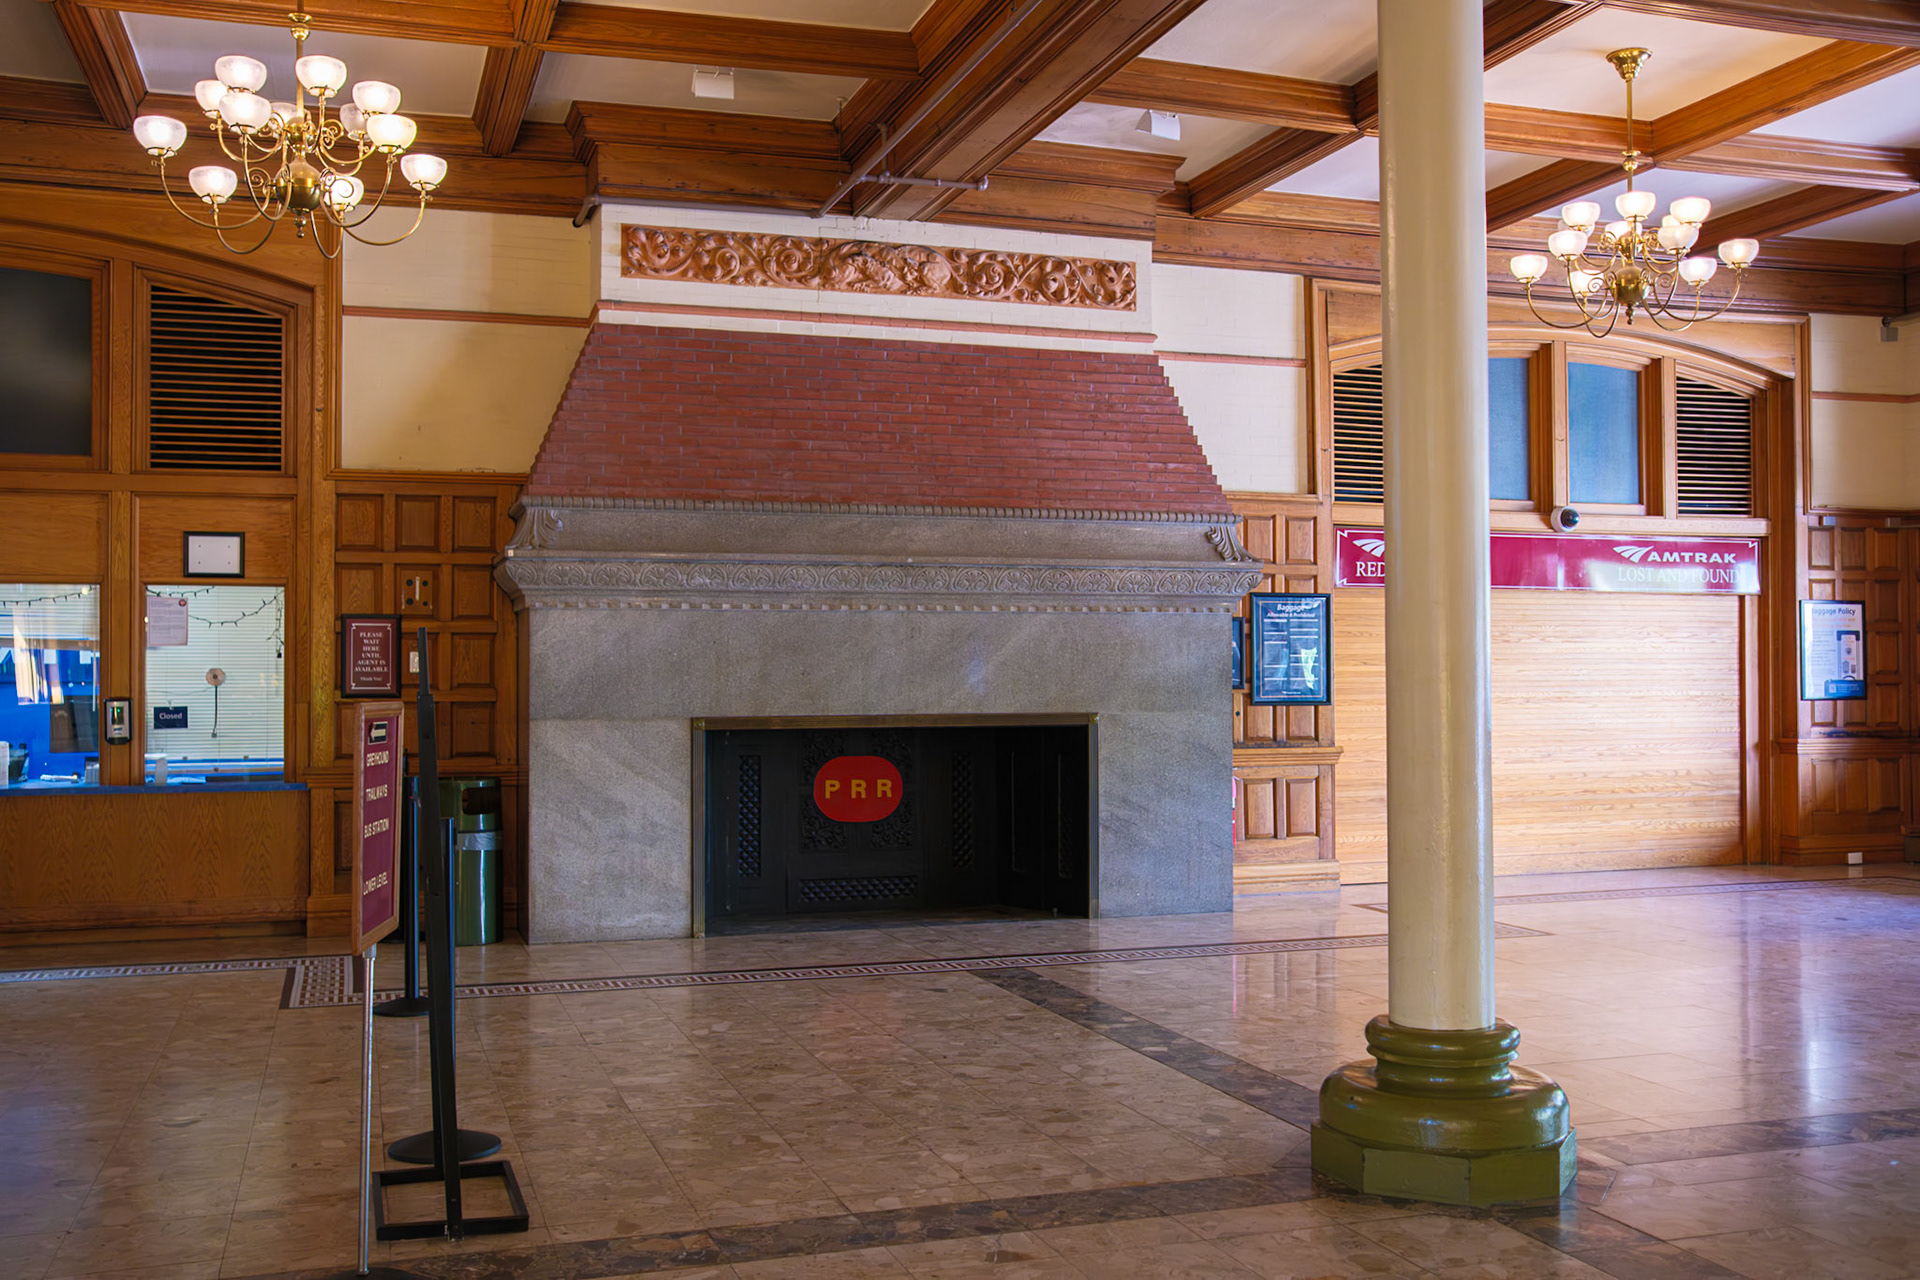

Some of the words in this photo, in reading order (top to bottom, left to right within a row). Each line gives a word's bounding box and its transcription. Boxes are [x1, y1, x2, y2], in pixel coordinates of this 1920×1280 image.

[1647, 551, 1737, 564] AMTRAK
[1355, 561, 1386, 577] RED
[1618, 567, 1655, 582] LOST
[1655, 567, 1690, 583] AND
[1691, 568, 1740, 584] FOUND
[1812, 608, 1836, 616] aggage
[1837, 607, 1856, 616] Policy
[159, 712, 183, 720] Closed
[366, 750, 390, 767] GREYHOUND
[366, 784, 388, 801] TRAILWAYS
[364, 823, 372, 839] BUS
[372, 817, 390, 836] STATION
[363, 873, 376, 896] LOWER
[376, 871, 388, 889] LEVEL
